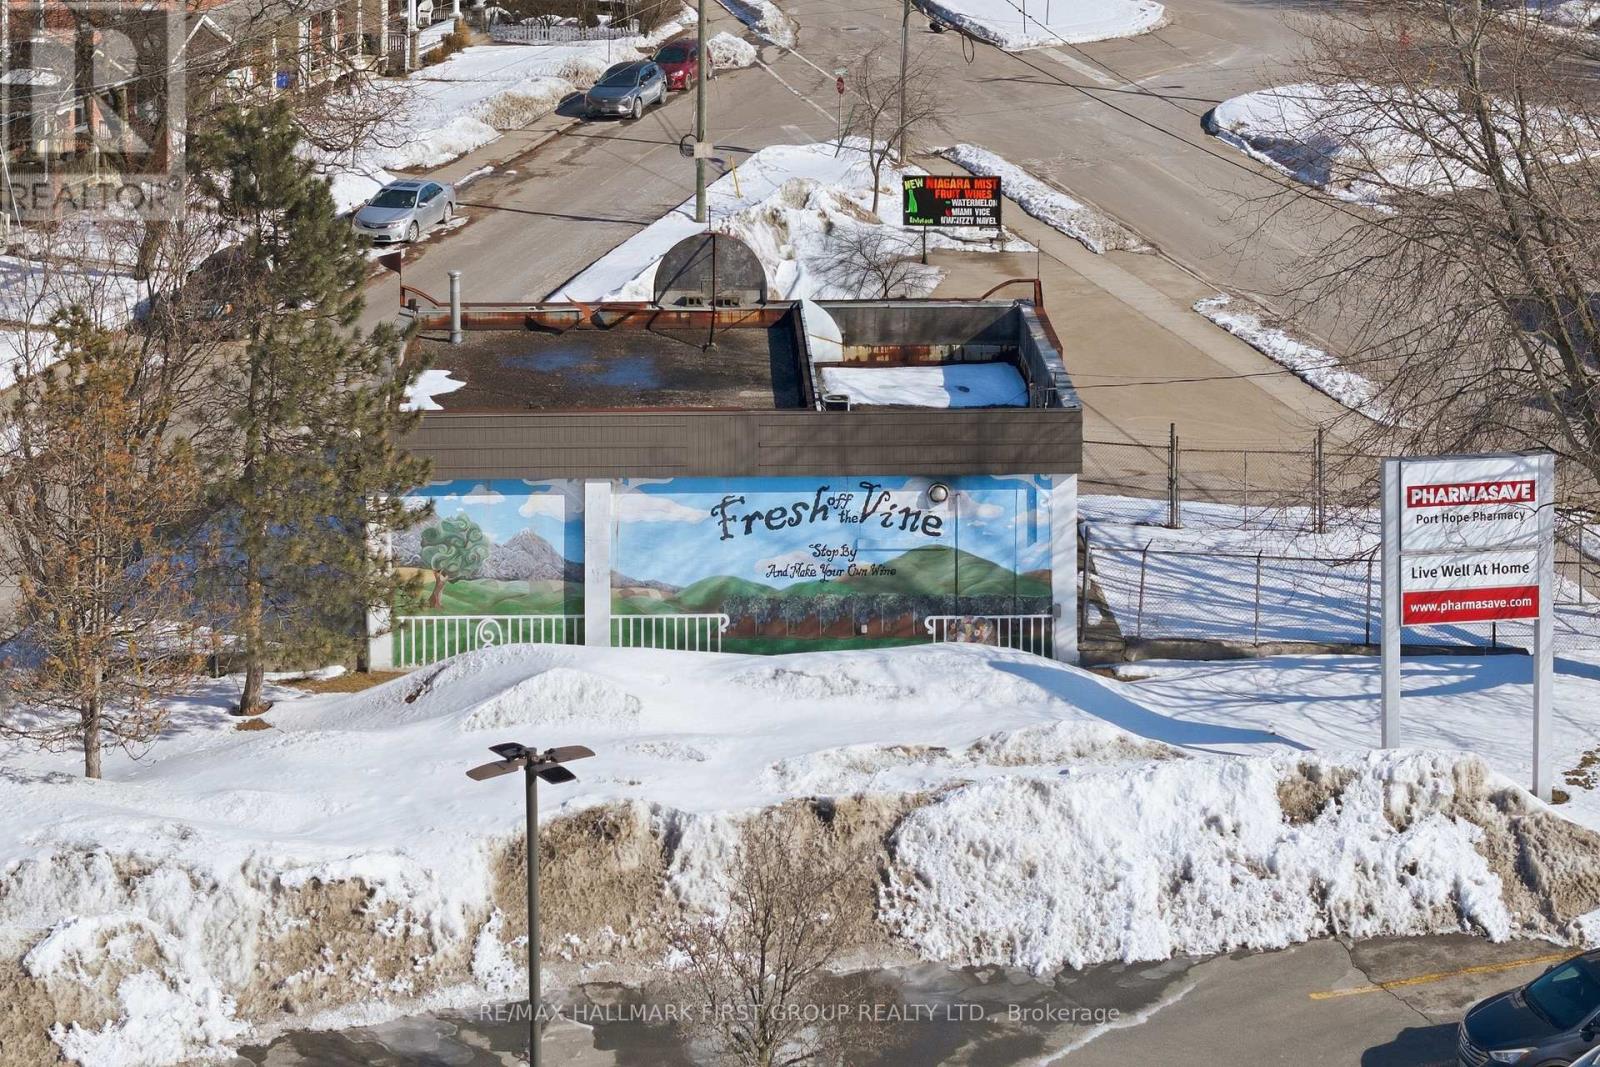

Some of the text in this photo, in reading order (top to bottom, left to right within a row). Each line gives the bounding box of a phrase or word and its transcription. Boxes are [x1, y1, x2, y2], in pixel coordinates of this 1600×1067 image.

[904, 178, 924, 190] NEW
[926, 177, 997, 189] NIAGARA MIST
[935, 189, 992, 199] FRUIT WINES
[951, 199, 998, 207] WATERMELON
[952, 208, 991, 216] MIAMI VICE
[1411, 483, 1531, 505] PHARMASAVE
[710, 481, 943, 541] Fresh off the Vine
[1416, 510, 1526, 526] Port Hope Pharmacy
[809, 543, 858, 562] Stop By
[766, 562, 897, 583] And Make Your Own Wine
[1411, 562, 1530, 579] Live Well At Home
[1410, 597, 1532, 614] www.pharmasave.com
